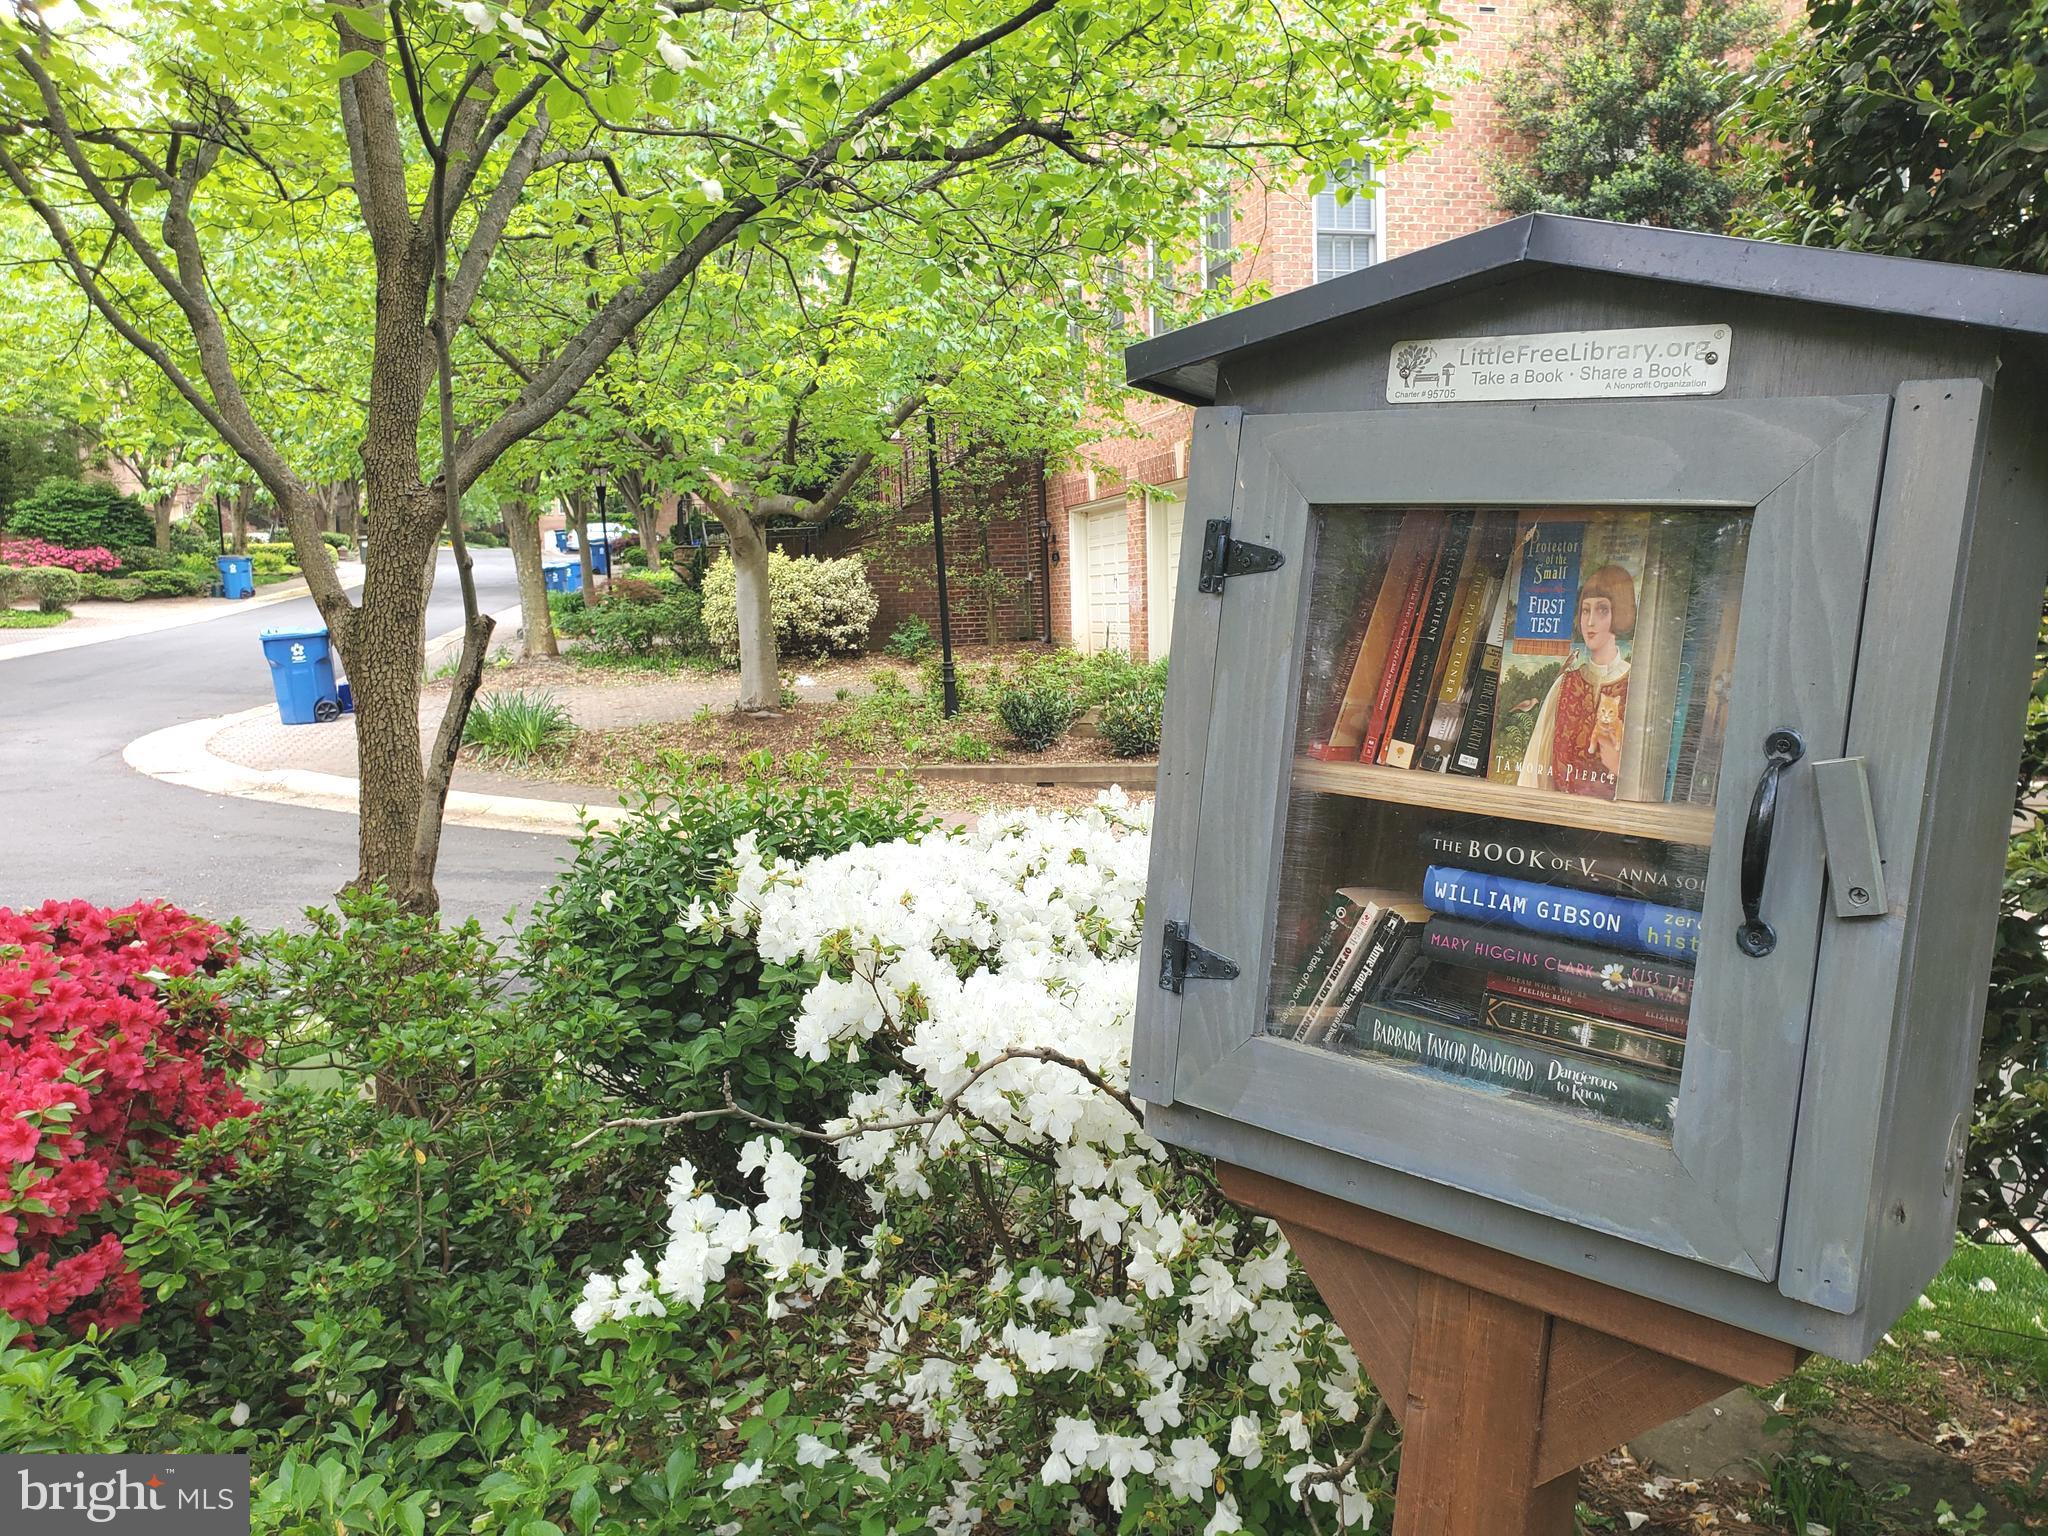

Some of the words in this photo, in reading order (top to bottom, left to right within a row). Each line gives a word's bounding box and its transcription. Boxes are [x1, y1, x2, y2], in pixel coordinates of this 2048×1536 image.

[1459, 340, 1711, 366] LittleFreeLibrary.org
[1472, 370, 1505, 385] Take
[1510, 373, 1519, 384] a
[1524, 368, 1564, 384] Book
[1579, 365, 1627, 381] Share
[1633, 367, 1643, 379] a
[1649, 362, 1692, 378] Book
[1605, 381, 1612, 390] A
[1613, 381, 1650, 390] Nonprofit
[1653, 379, 1707, 389] Organization
[1527, 528, 1579, 557] Protector
[1442, 529, 1462, 586] NGLISH
[1545, 554, 1554, 565] of
[1555, 554, 1567, 565] the
[1533, 562, 1568, 584] Small
[1427, 591, 1447, 643] PATIENT
[1528, 596, 1565, 615] FIRST
[1459, 604, 1476, 644] PIANO
[1530, 617, 1560, 633] TEST
[1445, 651, 1463, 694] TUNER
[1480, 675, 1497, 700] HERE
[1476, 703, 1490, 717] ON
[1466, 719, 1485, 751] EARTH
[1495, 755, 1553, 776] TAMORA
[1565, 764, 1617, 785] PIERCE
[1433, 838, 1462, 853] THE
[1468, 840, 1546, 870] BOOK
[1551, 858, 1573, 870] OF
[1579, 857, 1599, 877] V.
[1617, 867, 1668, 886] ANNA
[1434, 881, 1528, 914] WILLIAM
[1536, 901, 1621, 933] GIBSON
[1315, 946, 1325, 956] A
[1342, 947, 1352, 959] OF
[1366, 942, 1384, 967] Anne
[1430, 934, 1471, 952] MARY
[1474, 943, 1539, 967] HIGGINS
[1544, 957, 1595, 978] CLARK
[1631, 967, 1660, 985] KISS
[1306, 955, 1322, 974] Tale
[1330, 957, 1346, 981] MICE
[1293, 981, 1309, 1000] Two
[1300, 972, 1311, 986] of
[1320, 981, 1333, 999] AND
[1350, 965, 1373, 996] Frank:
[1506, 975, 1533, 986] DREAM
[1534, 981, 1557, 992] WHEN
[1559, 986, 1588, 999] YOU'RE
[1279, 998, 1297, 1023] Cities
[1344, 992, 1354, 1004] The
[1518, 986, 1550, 999] FEELING
[1552, 994, 1573, 1004] BLUE
[1645, 1010, 1690, 1026] ELIZABET
[1297, 1016, 1313, 1039] JOHN
[1373, 1018, 1422, 1054] BARBARA
[1427, 1032, 1466, 1065] TAYLOR
[1470, 1043, 1534, 1081] BRADFORD
[1547, 1059, 1618, 1092] Dangerous
[1556, 1079, 1570, 1094] to
[1571, 1085, 1607, 1106] Know
